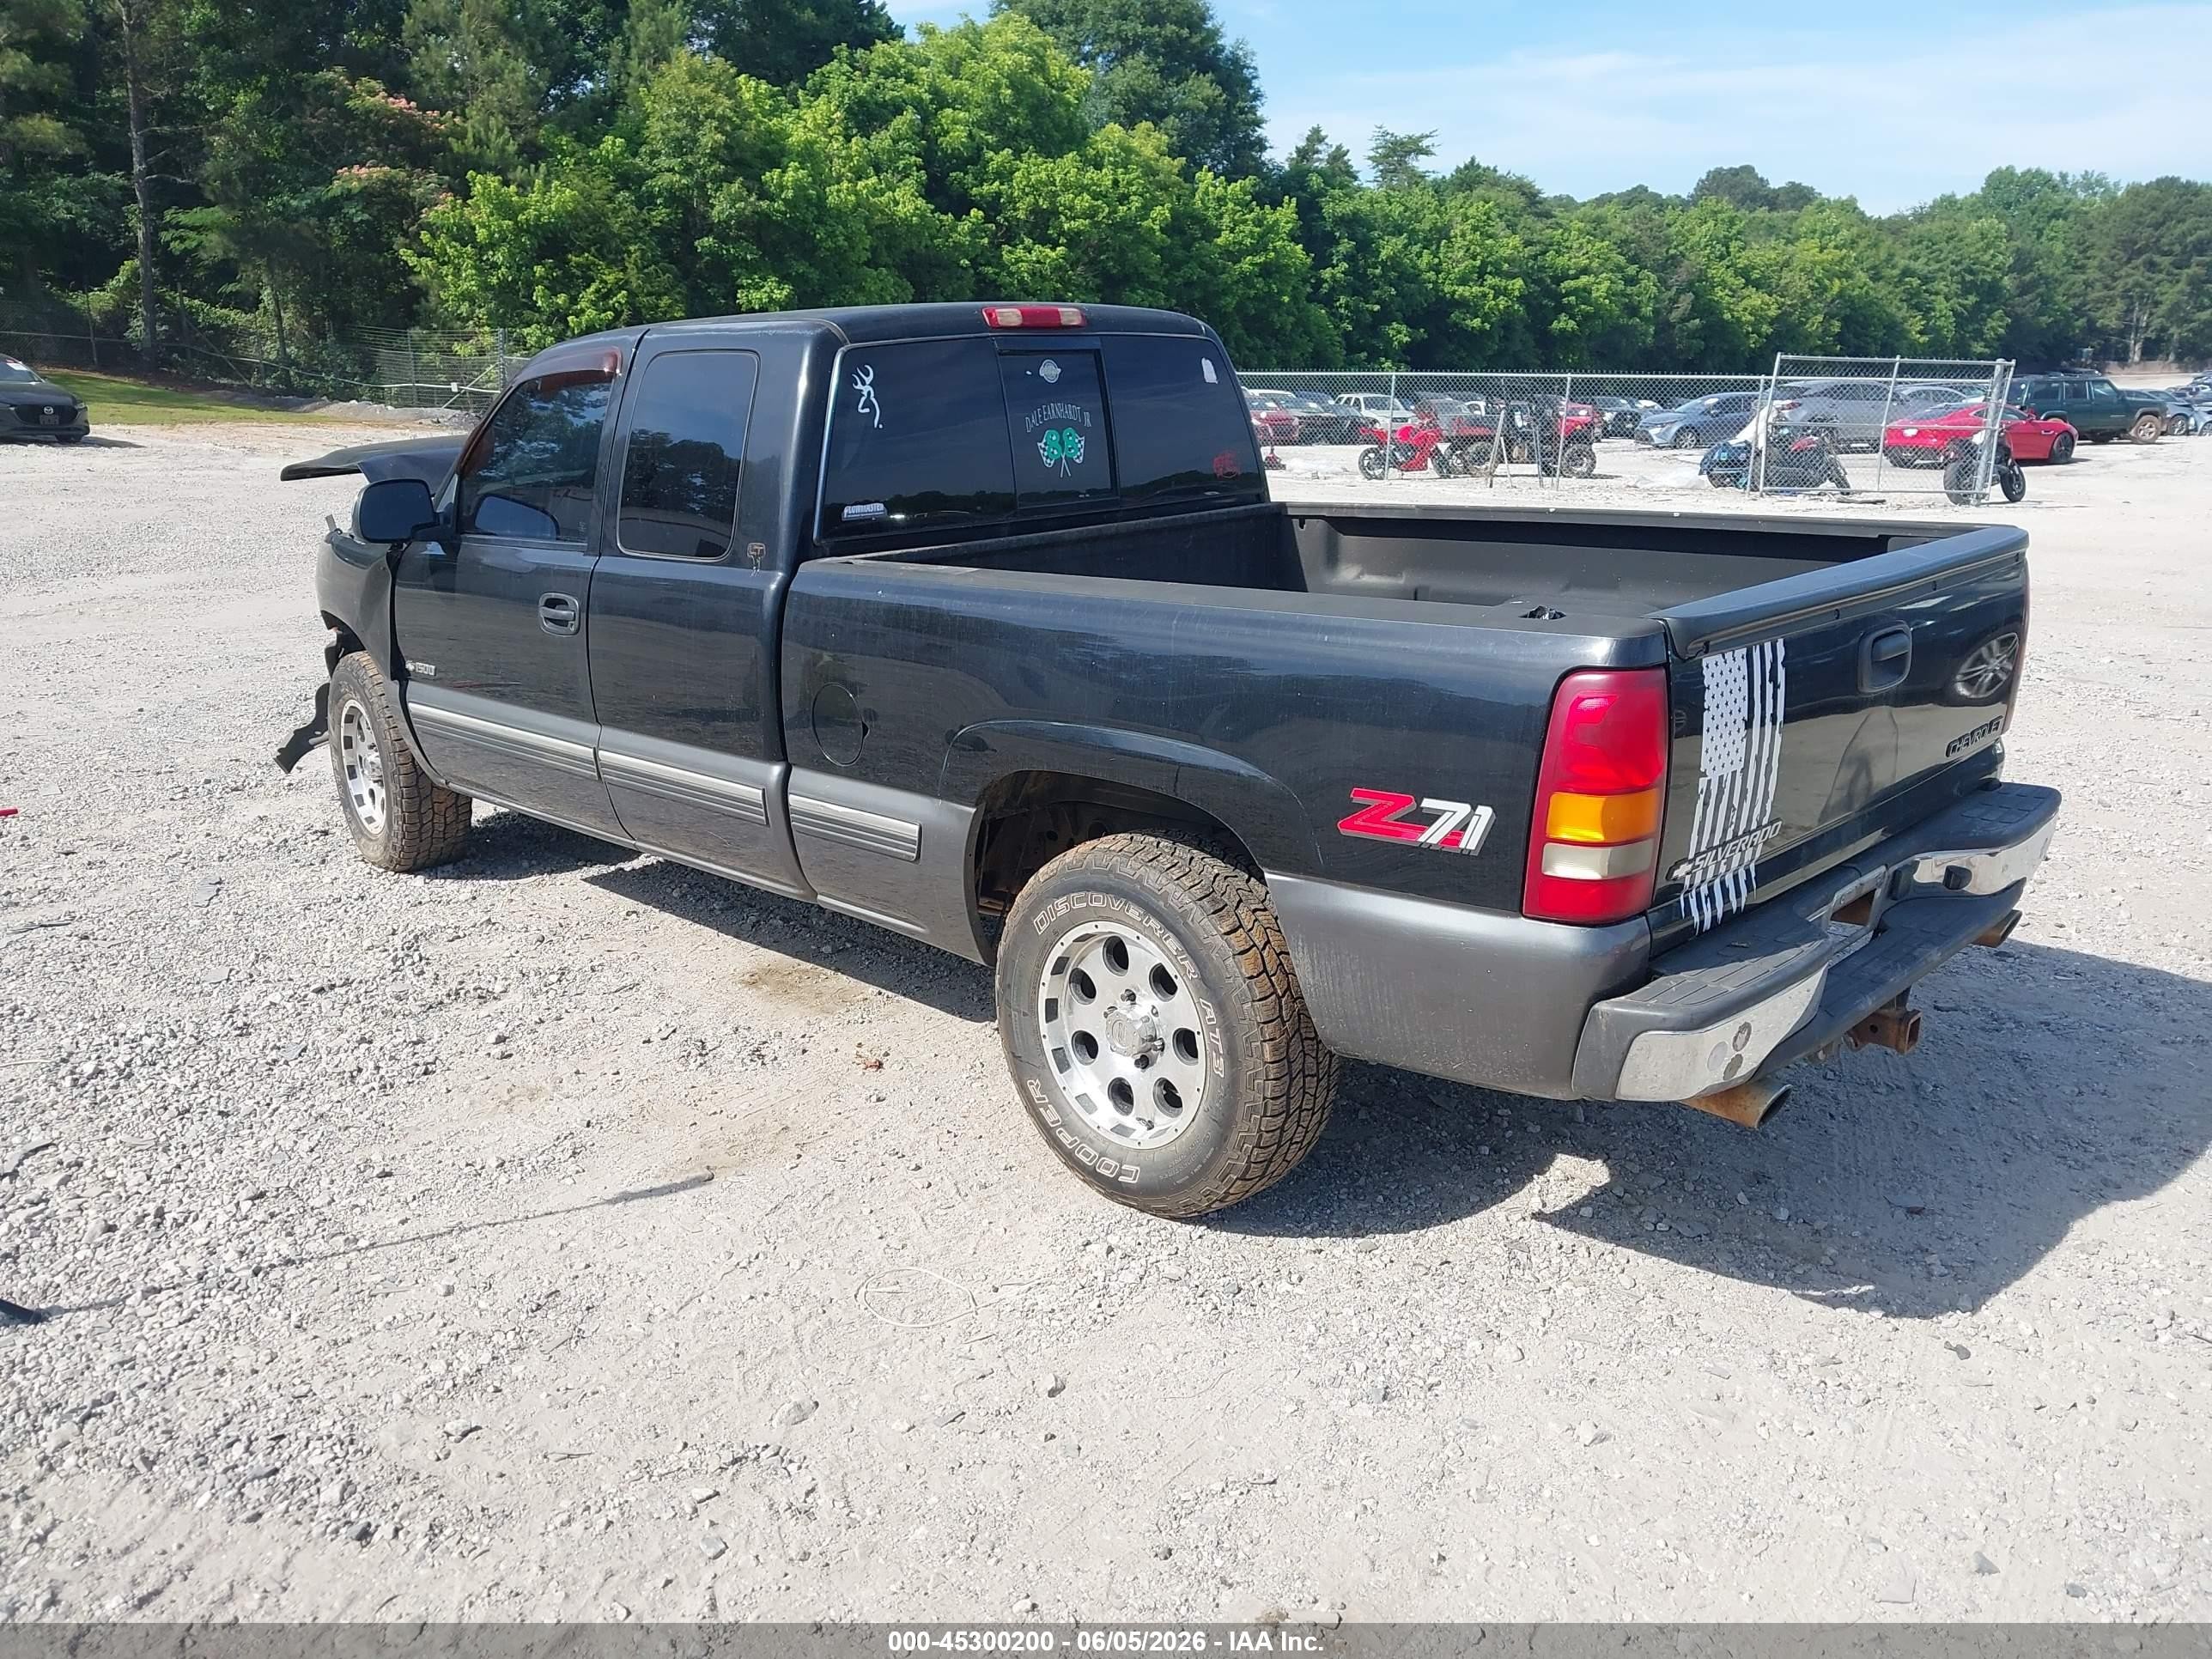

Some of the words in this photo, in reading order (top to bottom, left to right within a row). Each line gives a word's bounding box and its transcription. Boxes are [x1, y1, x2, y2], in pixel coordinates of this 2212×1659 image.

[1025, 408, 1042, 433] DALE
[1042, 403, 1082, 422] EARNHARDT
[1083, 411, 1092, 428] JR
[1337, 787, 1497, 856] Z71
[1691, 820, 1784, 873] SILVERADO
[1033, 890, 1200, 981] DISCOVERER
[1199, 996, 1226, 1079] AT3
[1026, 1077, 1141, 1185] COOPER
